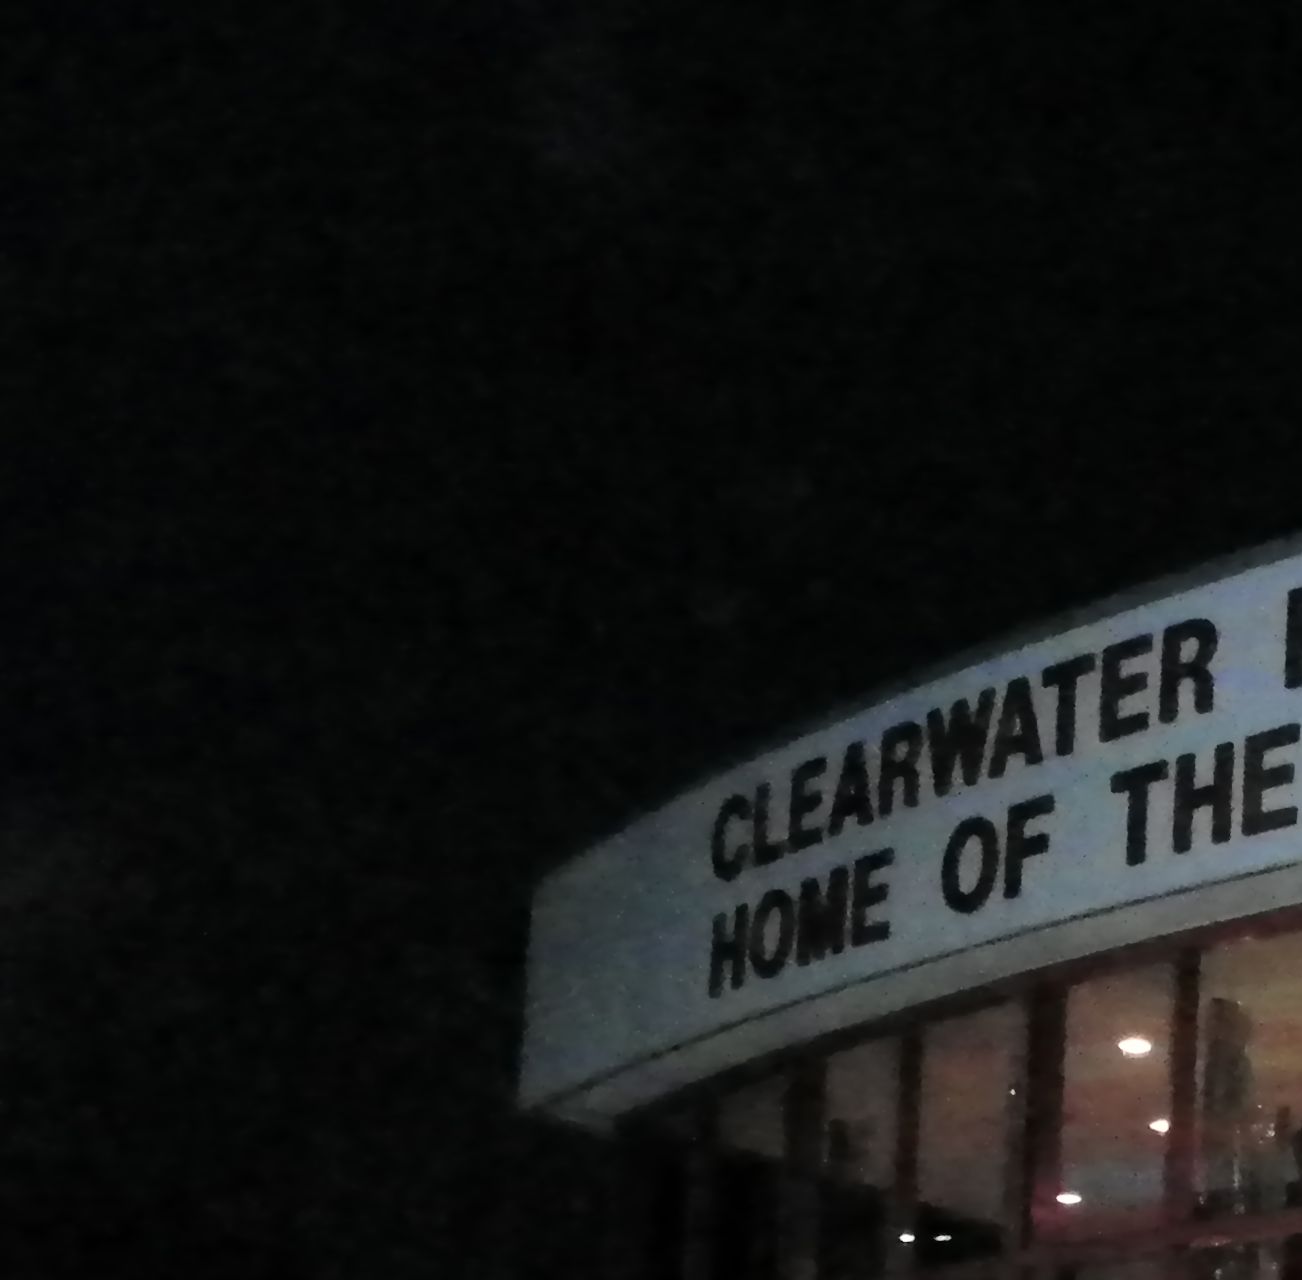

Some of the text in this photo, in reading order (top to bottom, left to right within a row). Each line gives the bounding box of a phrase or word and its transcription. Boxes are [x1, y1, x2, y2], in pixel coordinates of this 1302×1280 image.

[708, 847, 895, 999] HOME
[940, 794, 1056, 915] OF
[1109, 722, 1301, 867] THE
[709, 616, 1219, 883] CLEARWATER
